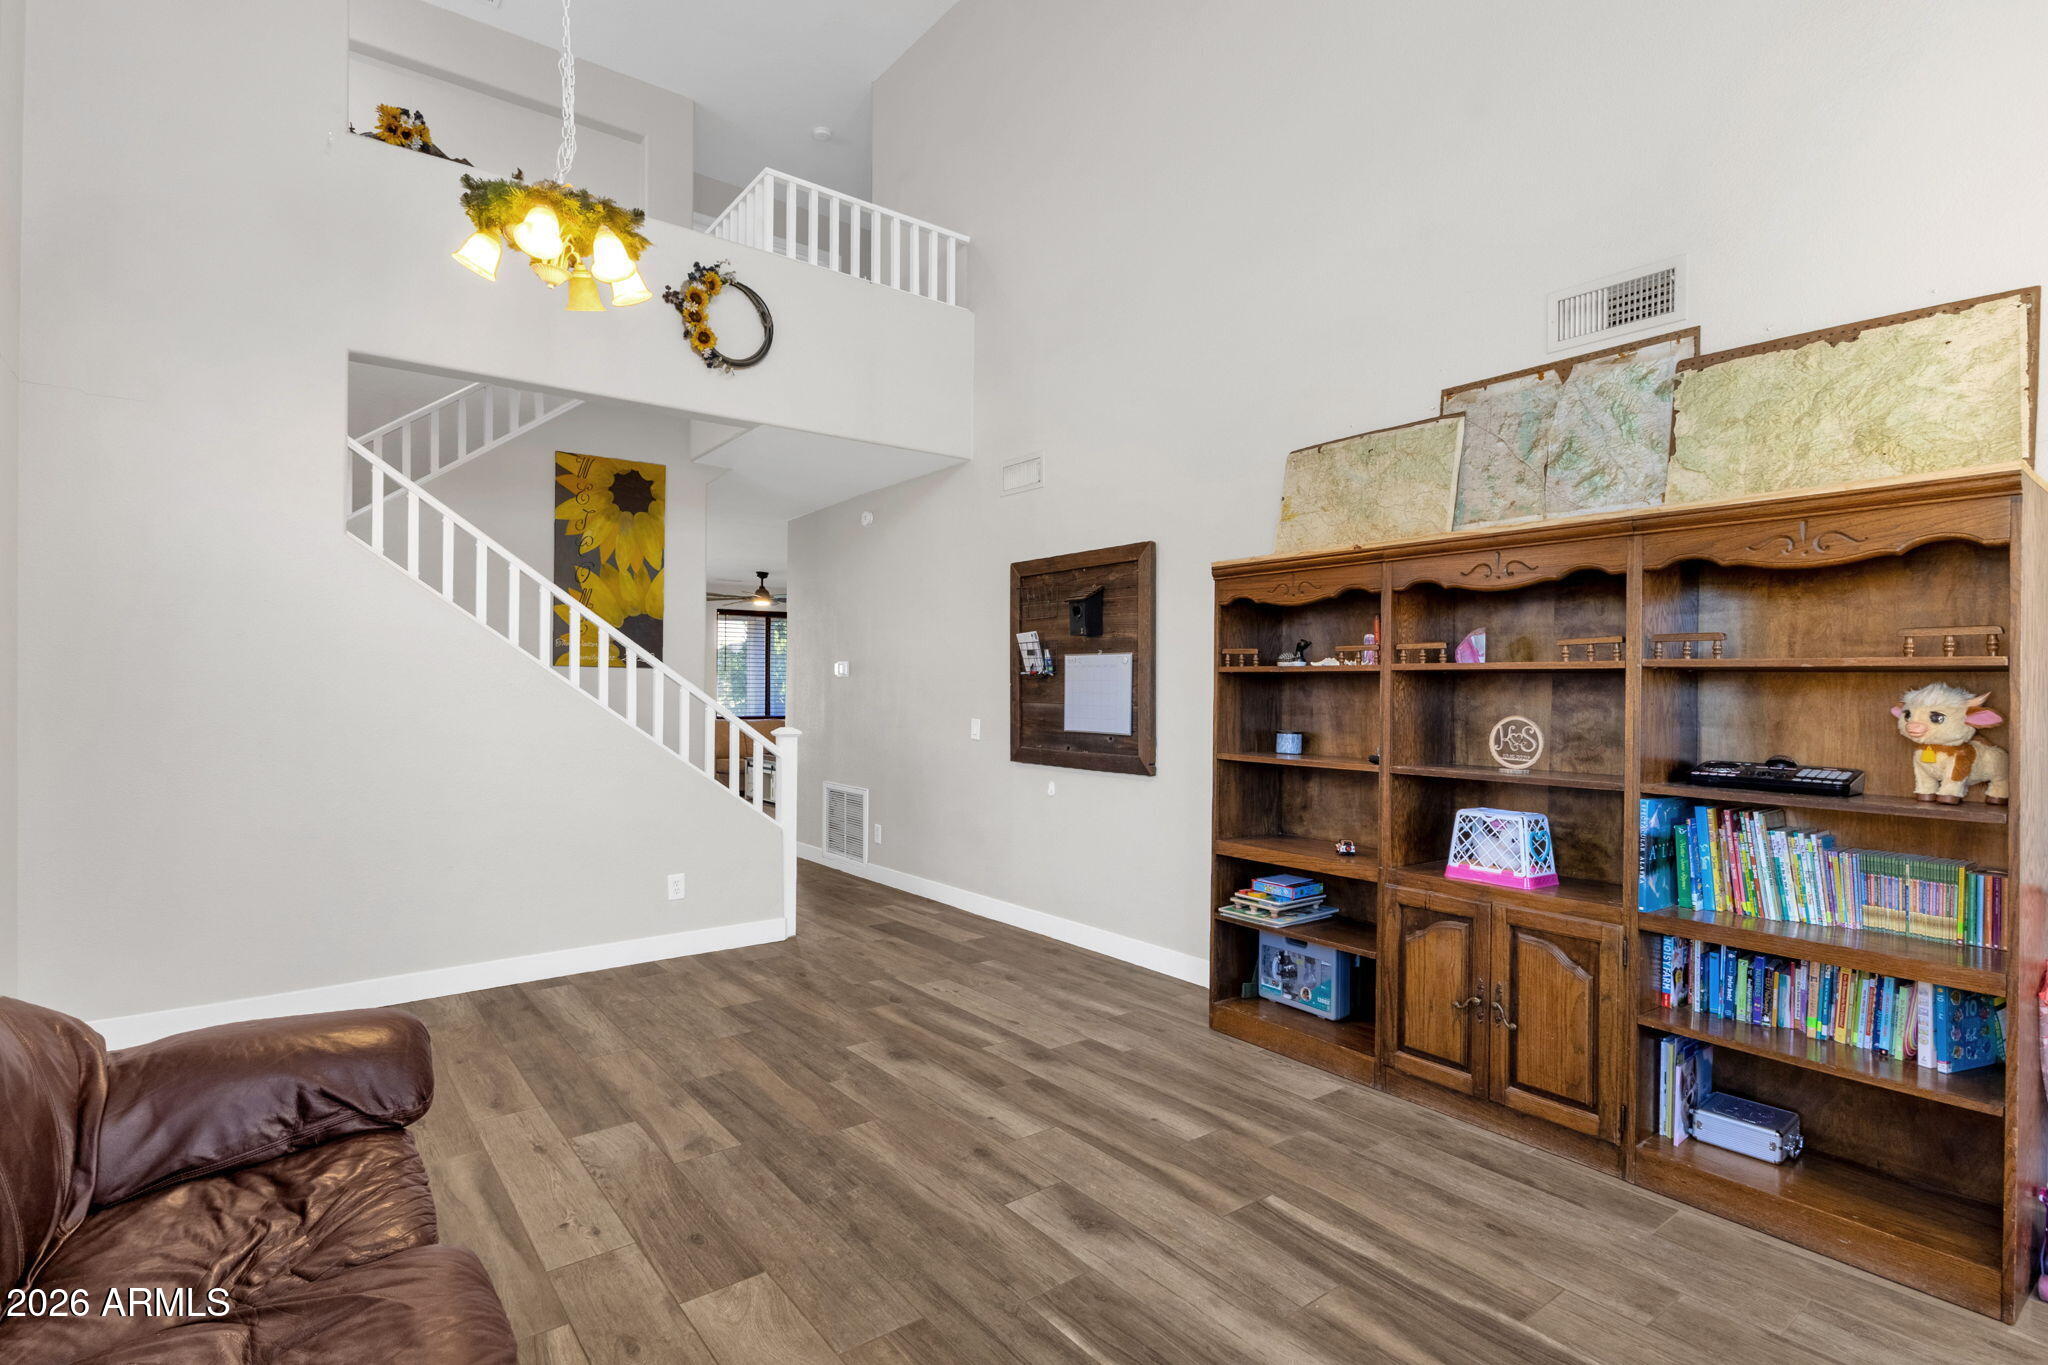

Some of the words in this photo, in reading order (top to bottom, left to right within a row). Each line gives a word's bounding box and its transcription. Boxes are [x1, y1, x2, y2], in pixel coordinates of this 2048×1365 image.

[1640, 803, 1649, 852] SPECTACULAR
[1639, 856, 1647, 884] ALASKA
[1662, 937, 1672, 966] NOISY
[1661, 966, 1671, 990] FARM
[1965, 1000, 1978, 1017] 10
